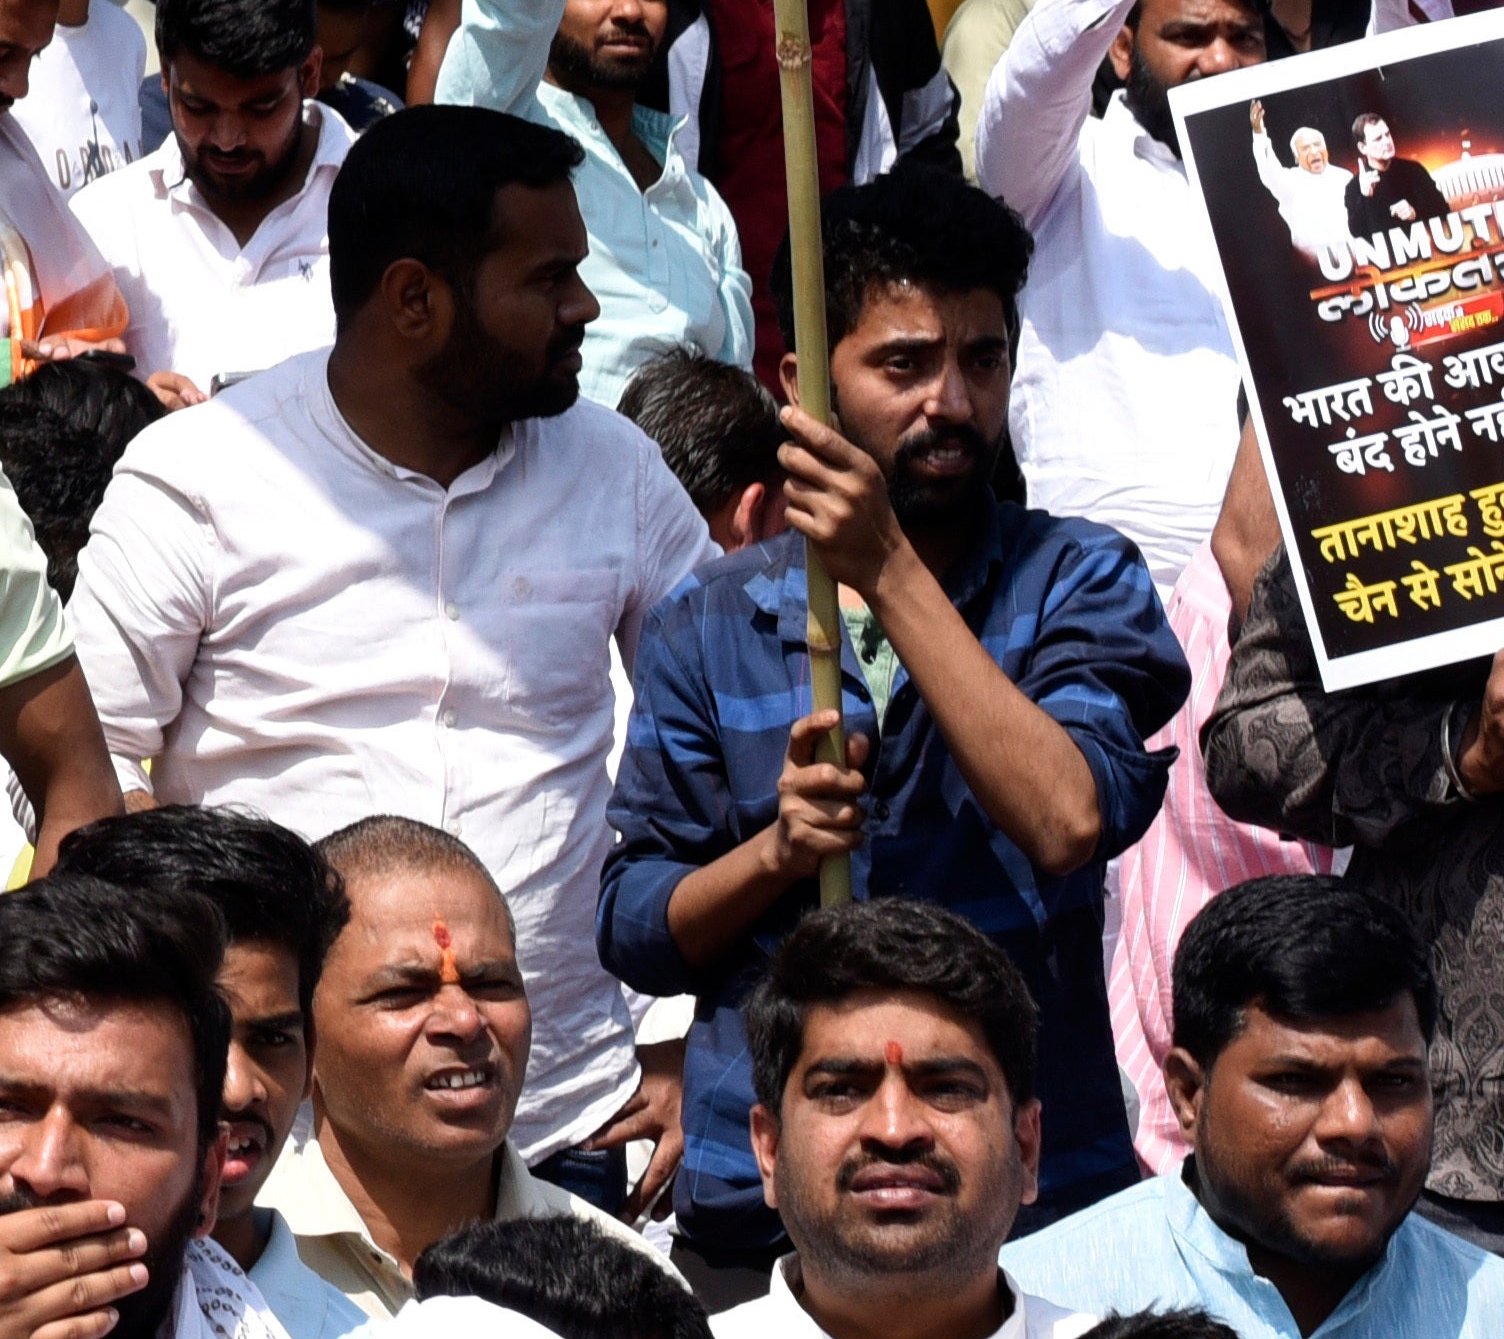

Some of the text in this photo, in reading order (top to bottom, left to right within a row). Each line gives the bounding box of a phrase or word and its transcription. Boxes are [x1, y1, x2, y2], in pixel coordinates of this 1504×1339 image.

[1282, 377, 1374, 429] भारत
[1375, 353, 1434, 406] की
[1327, 426, 1395, 476] बंद
[1391, 404, 1463, 467] होने
[1310, 493, 1469, 564] तानाशाह
[1332, 572, 1399, 624] चैन
[1400, 560, 1441, 612] से
